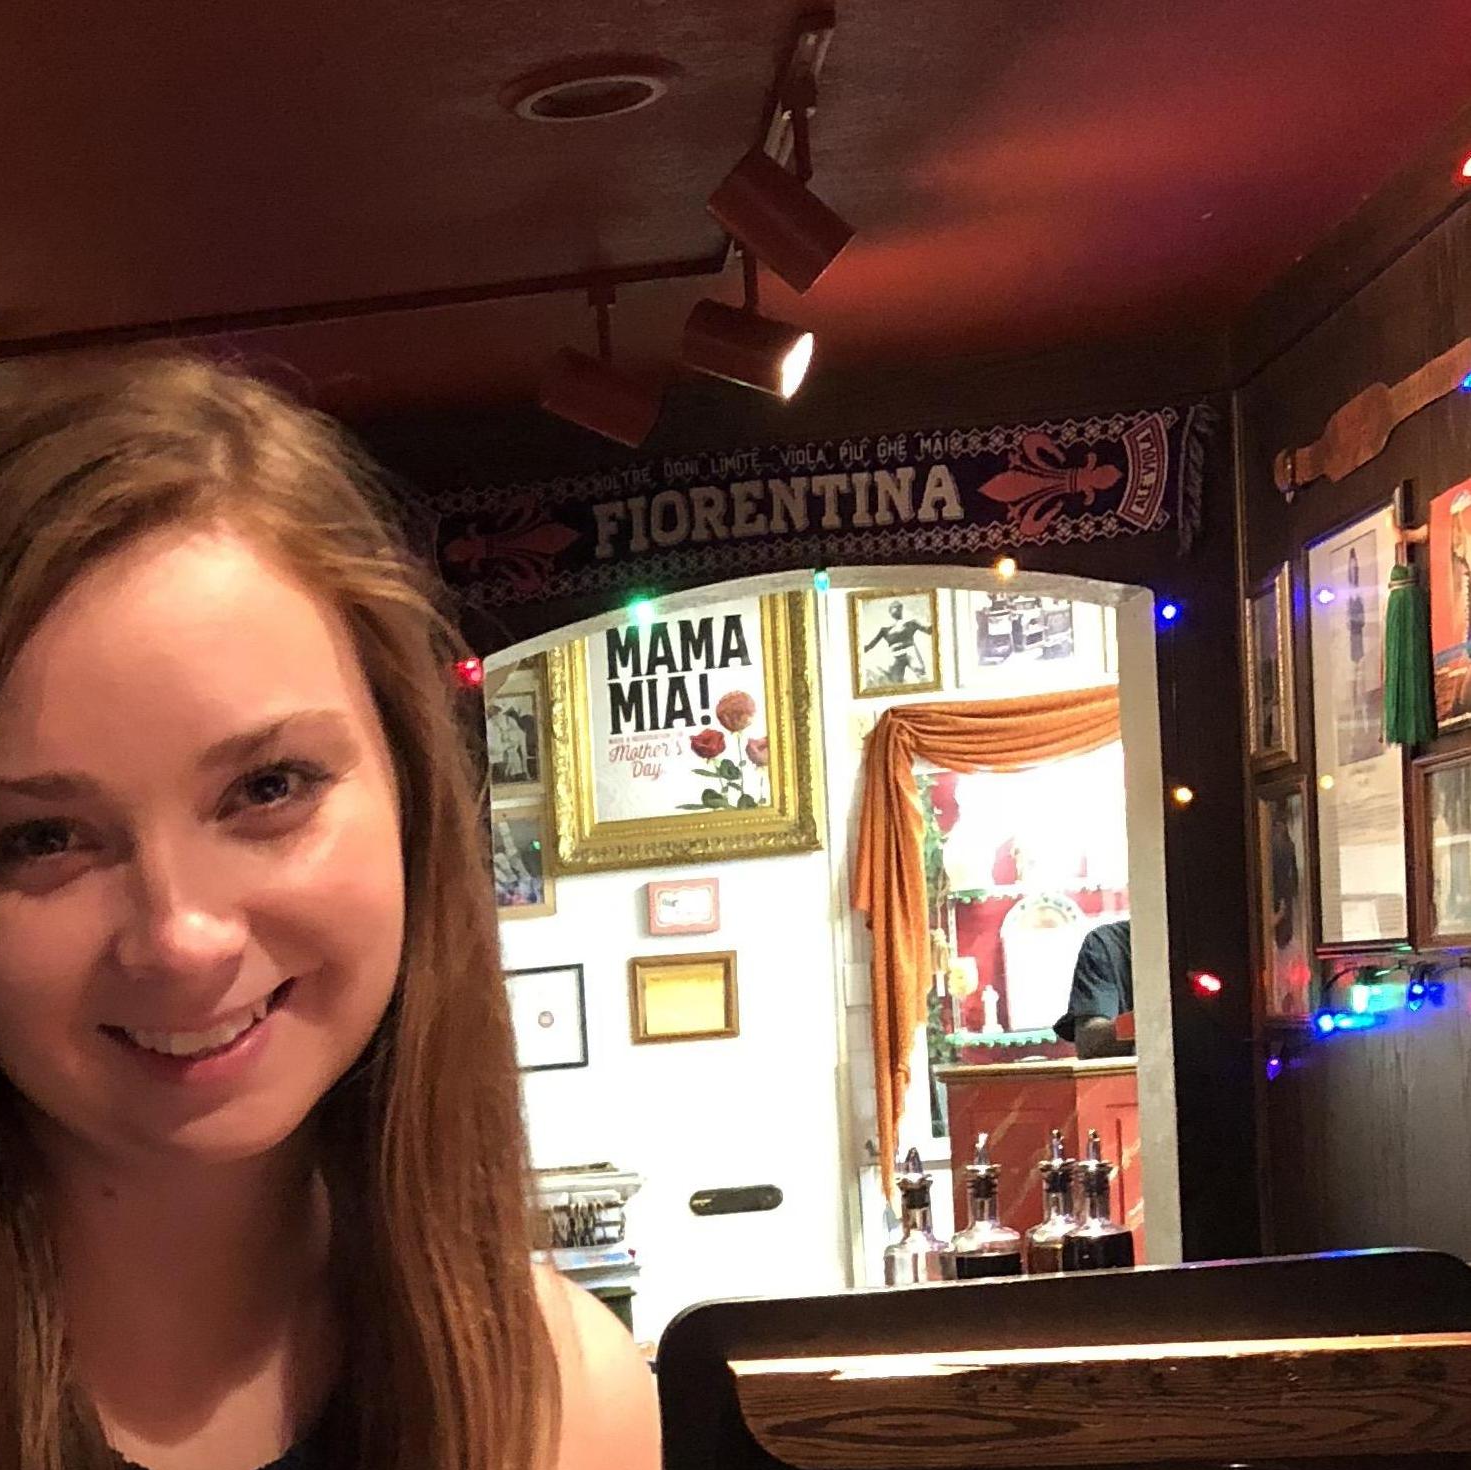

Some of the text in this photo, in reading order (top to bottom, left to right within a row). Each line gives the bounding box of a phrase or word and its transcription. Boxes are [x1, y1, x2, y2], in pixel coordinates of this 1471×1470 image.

[781, 449, 827, 466] VIOLA
[919, 437, 949, 454] MAI
[593, 464, 965, 560] FIORENTINA
[606, 614, 752, 681] MAMA
[608, 672, 711, 735] MIA!
[609, 741, 682, 763] Mothers
